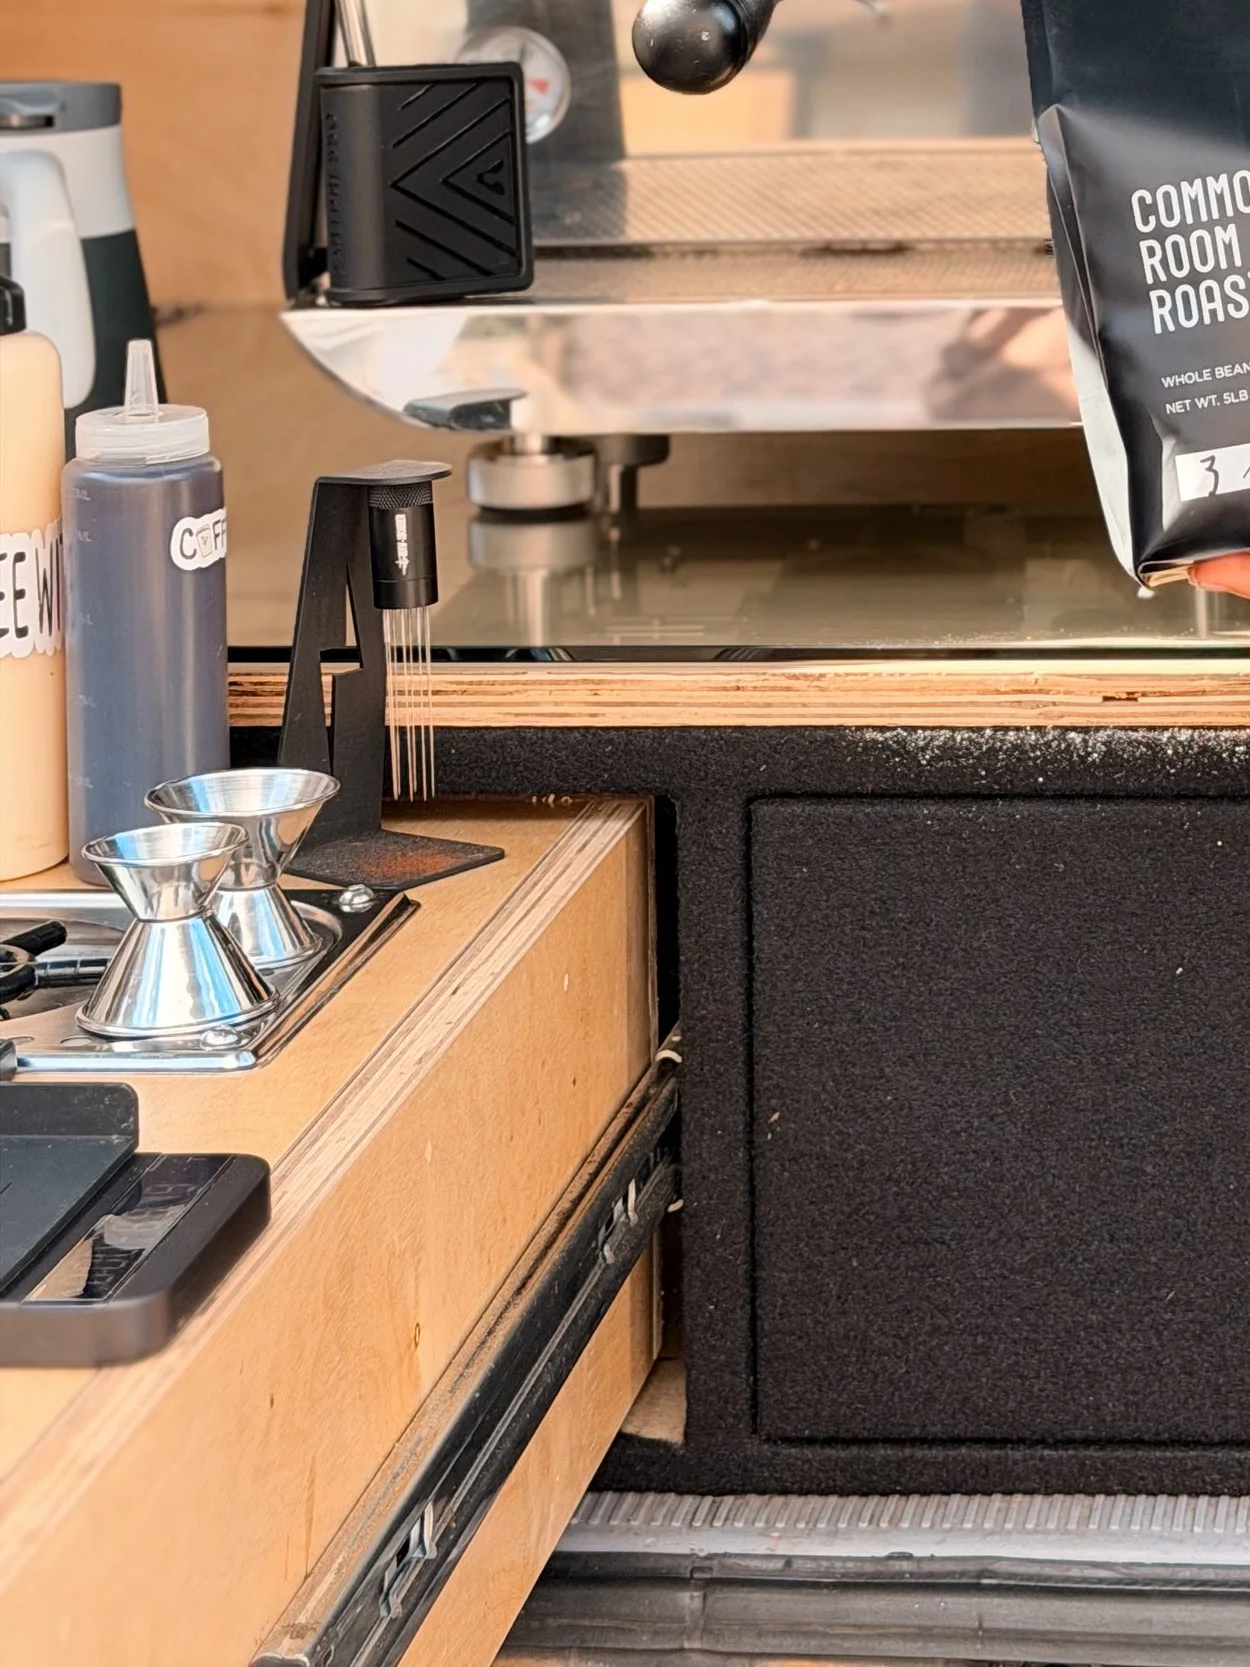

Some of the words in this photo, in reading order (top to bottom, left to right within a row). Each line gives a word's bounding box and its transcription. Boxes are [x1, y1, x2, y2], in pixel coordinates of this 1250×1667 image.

[1138, 223, 1243, 284] ROOM
[1161, 369, 1213, 389] WHOLE
[1165, 399, 1192, 415] NET
[1194, 394, 1221, 410] WT.
[1223, 389, 1249, 405] 5LB
